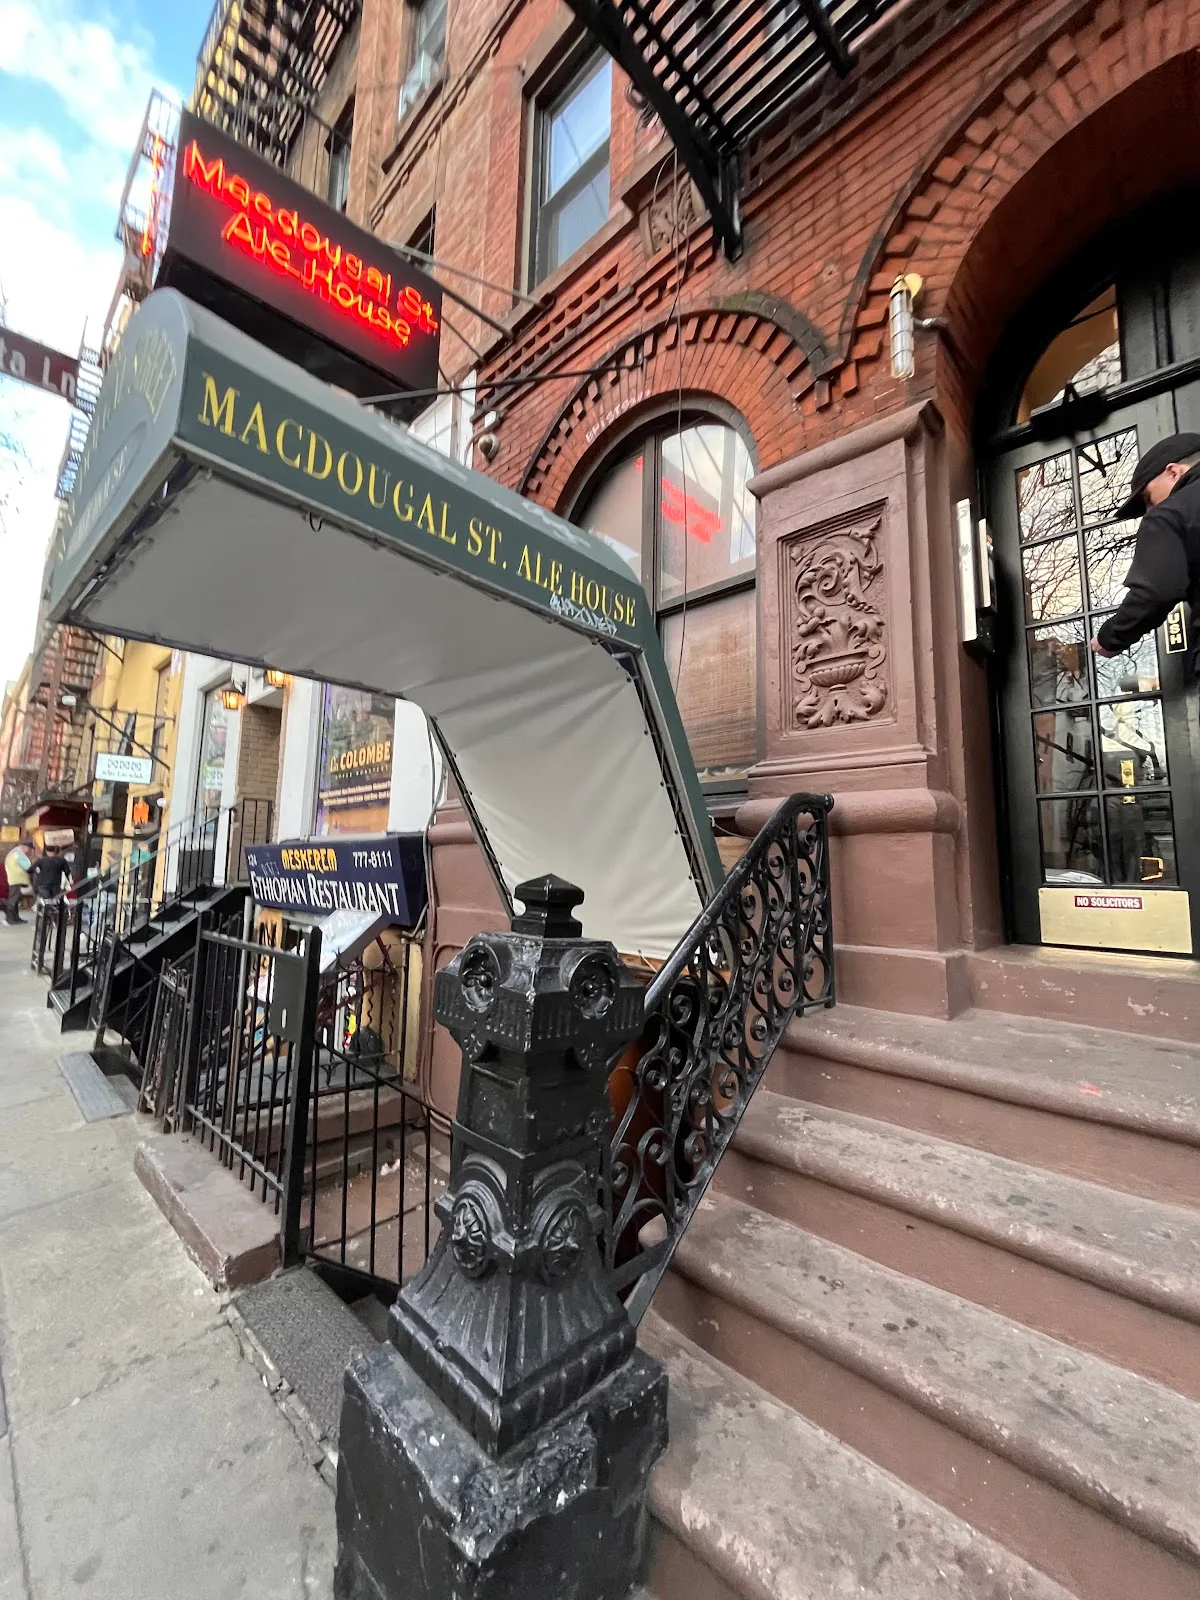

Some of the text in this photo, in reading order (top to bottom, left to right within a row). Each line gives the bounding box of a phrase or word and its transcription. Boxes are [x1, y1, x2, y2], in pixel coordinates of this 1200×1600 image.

[222, 211, 411, 346] Ale House
[42, 356, 76, 399] Ln
[198, 372, 457, 545] MACDOUGAL
[467, 516, 507, 570] ST.
[516, 544, 563, 596] ALE
[571, 569, 637, 628] HOUSE
[1167, 611, 1183, 645] USH
[340, 741, 391, 771] COLOMBE
[353, 850, 393, 869] 777-8111
[250, 871, 400, 917] ETHIOPIAN RESTAURANT
[1076, 896, 1141, 909] NO SOLICITORS
